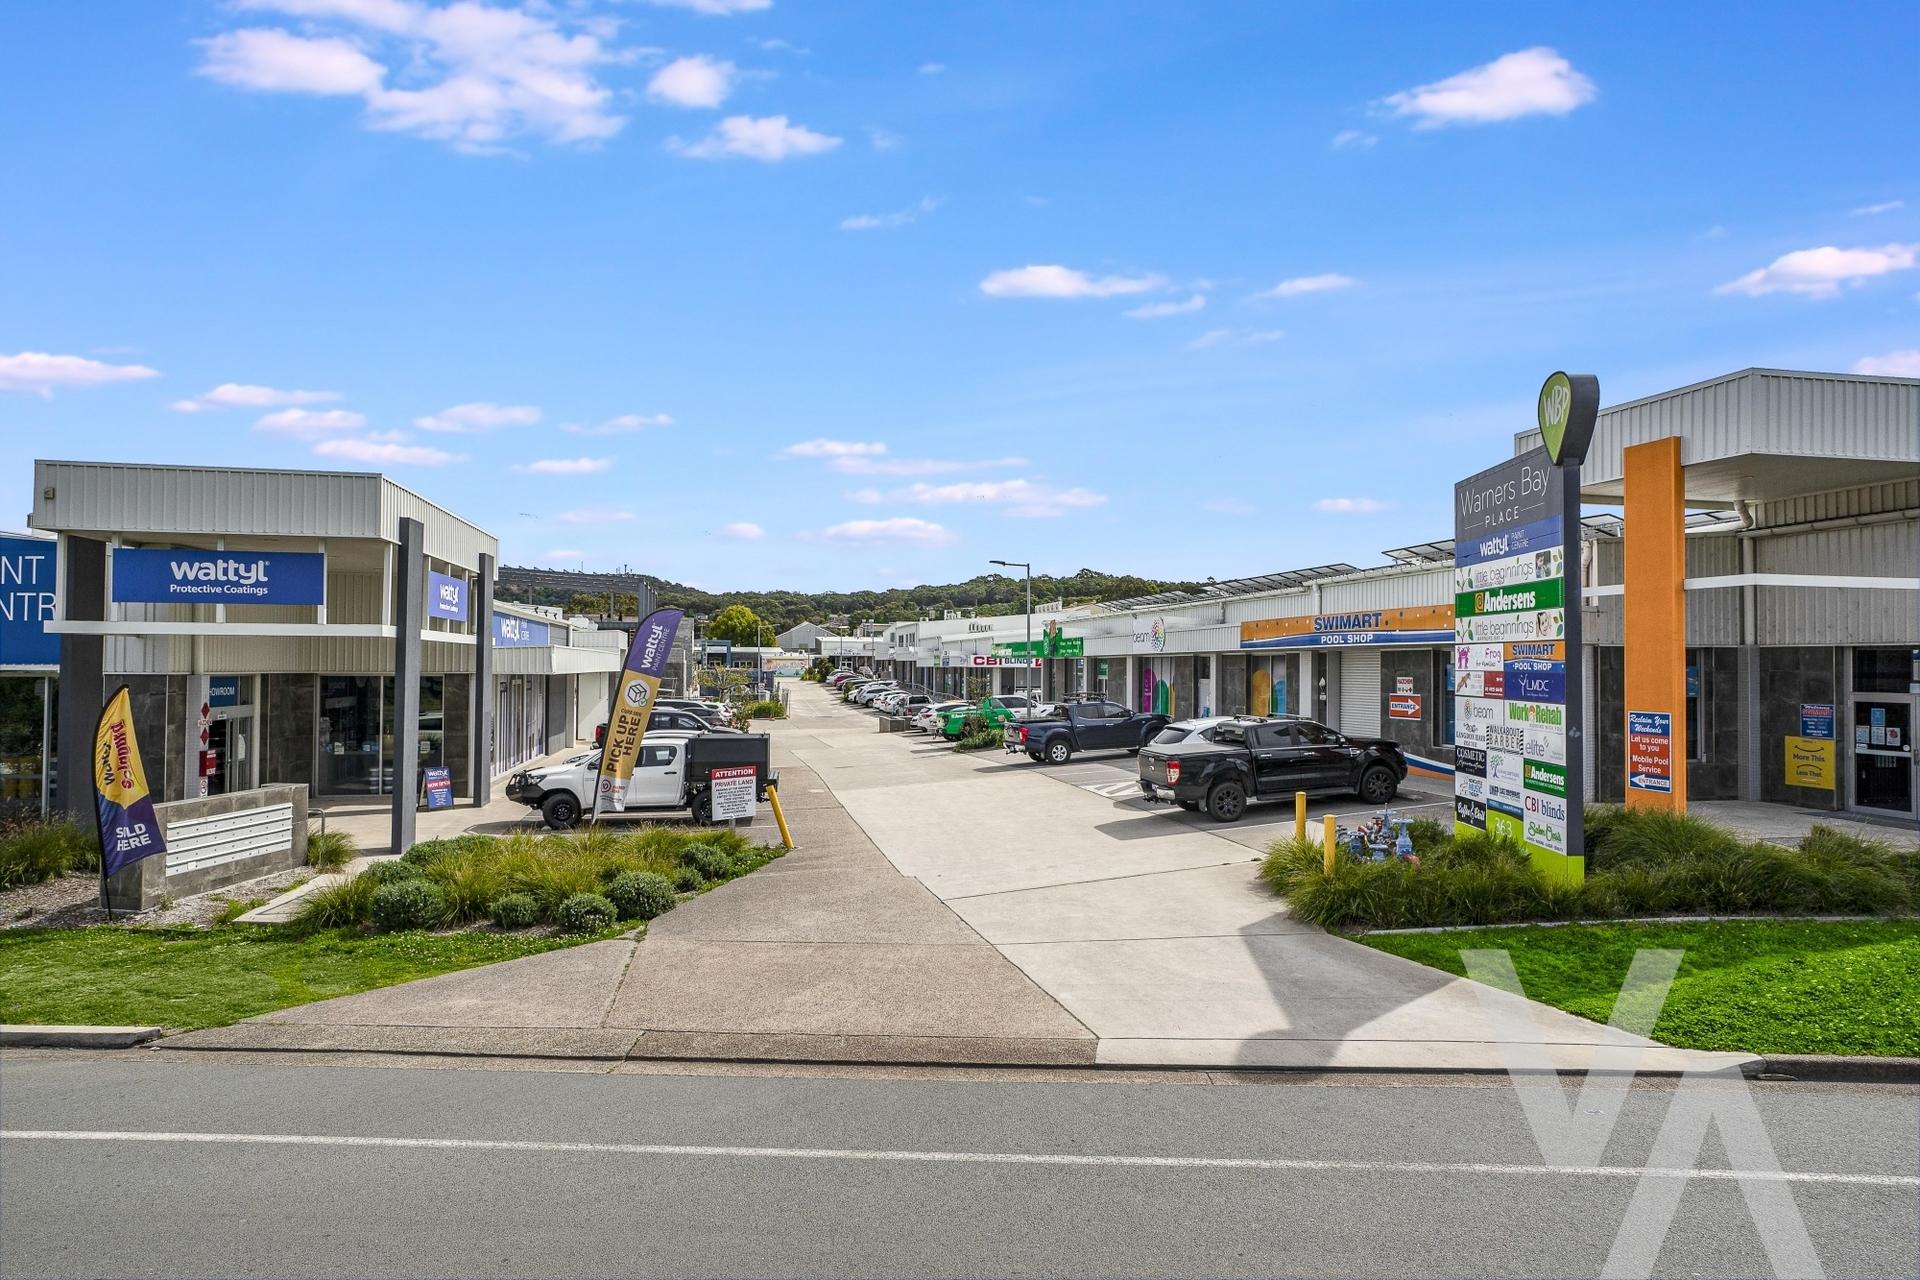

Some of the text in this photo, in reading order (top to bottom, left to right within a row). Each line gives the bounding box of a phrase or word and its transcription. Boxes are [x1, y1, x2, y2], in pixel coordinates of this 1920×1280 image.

[1543, 385, 1569, 427] WBP
[1460, 466, 1550, 518] Warners Bay
[1484, 506, 1520, 528] PLACE
[1480, 534, 1510, 558] wattyl
[1490, 561, 1534, 584] beginnings
[170, 584, 268, 597] Protective Coatings
[440, 583, 459, 603] wattyl
[1484, 589, 1536, 613] Andersens
[1314, 612, 1382, 631] SWIMART
[1490, 619, 1534, 639] beginnings
[641, 624, 664, 668] wattyl
[1321, 633, 1374, 645] POOL SHOP
[1485, 647, 1501, 664] Frog
[1512, 643, 1555, 656] SWIMART
[974, 656, 1003, 666] CBI
[1515, 662, 1552, 670] POOL SHOP
[1391, 702, 1416, 710] ENTRANCE
[1473, 703, 1494, 720] beam
[1509, 702, 1562, 726] Work Rehab
[1630, 713, 1669, 727] Reclaim Your
[1634, 723, 1662, 734] Weekends
[606, 739, 624, 774] PICK
[616, 715, 630, 735] UP
[622, 716, 641, 756] HERE
[1489, 733, 1521, 750] BARBER
[1630, 735, 1641, 743] Let
[1650, 737, 1669, 745] come
[1456, 748, 1485, 762] COSMETIC
[1525, 739, 1545, 757] elite
[1640, 743, 1646, 751] to
[1632, 754, 1669, 766] Mobile Pool
[1792, 752, 1810, 761] More
[715, 768, 754, 778] ATTENTION
[1531, 766, 1565, 786] Andersens
[1638, 764, 1662, 774] Service
[715, 779, 754, 789] PRIVATE LAND
[1638, 778, 1668, 787] ENTRANCE
[1524, 795, 1540, 813] CBI
[1541, 799, 1566, 822] blinds
[116, 837, 152, 852] HERE
